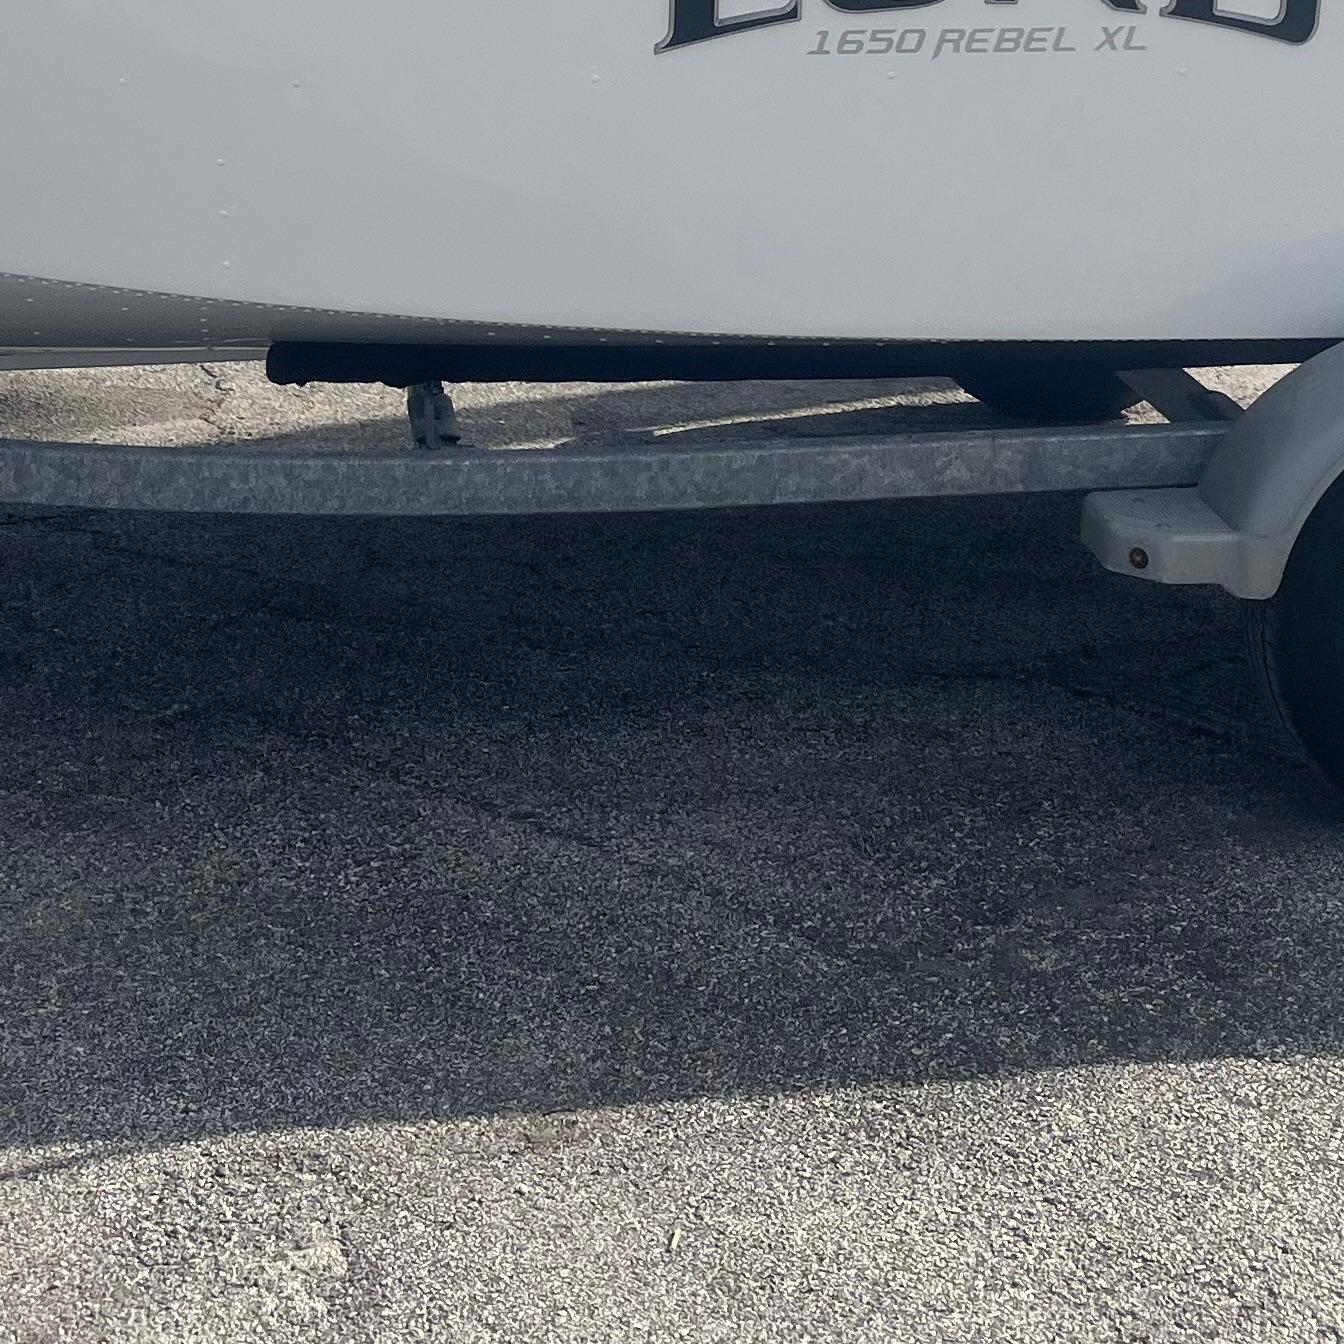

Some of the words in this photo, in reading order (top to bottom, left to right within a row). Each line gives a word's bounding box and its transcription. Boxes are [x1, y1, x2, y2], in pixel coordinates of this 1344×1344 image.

[806, 28, 926, 56] 1650
[931, 26, 1077, 61] REBEL
[1093, 25, 1147, 52] XL
